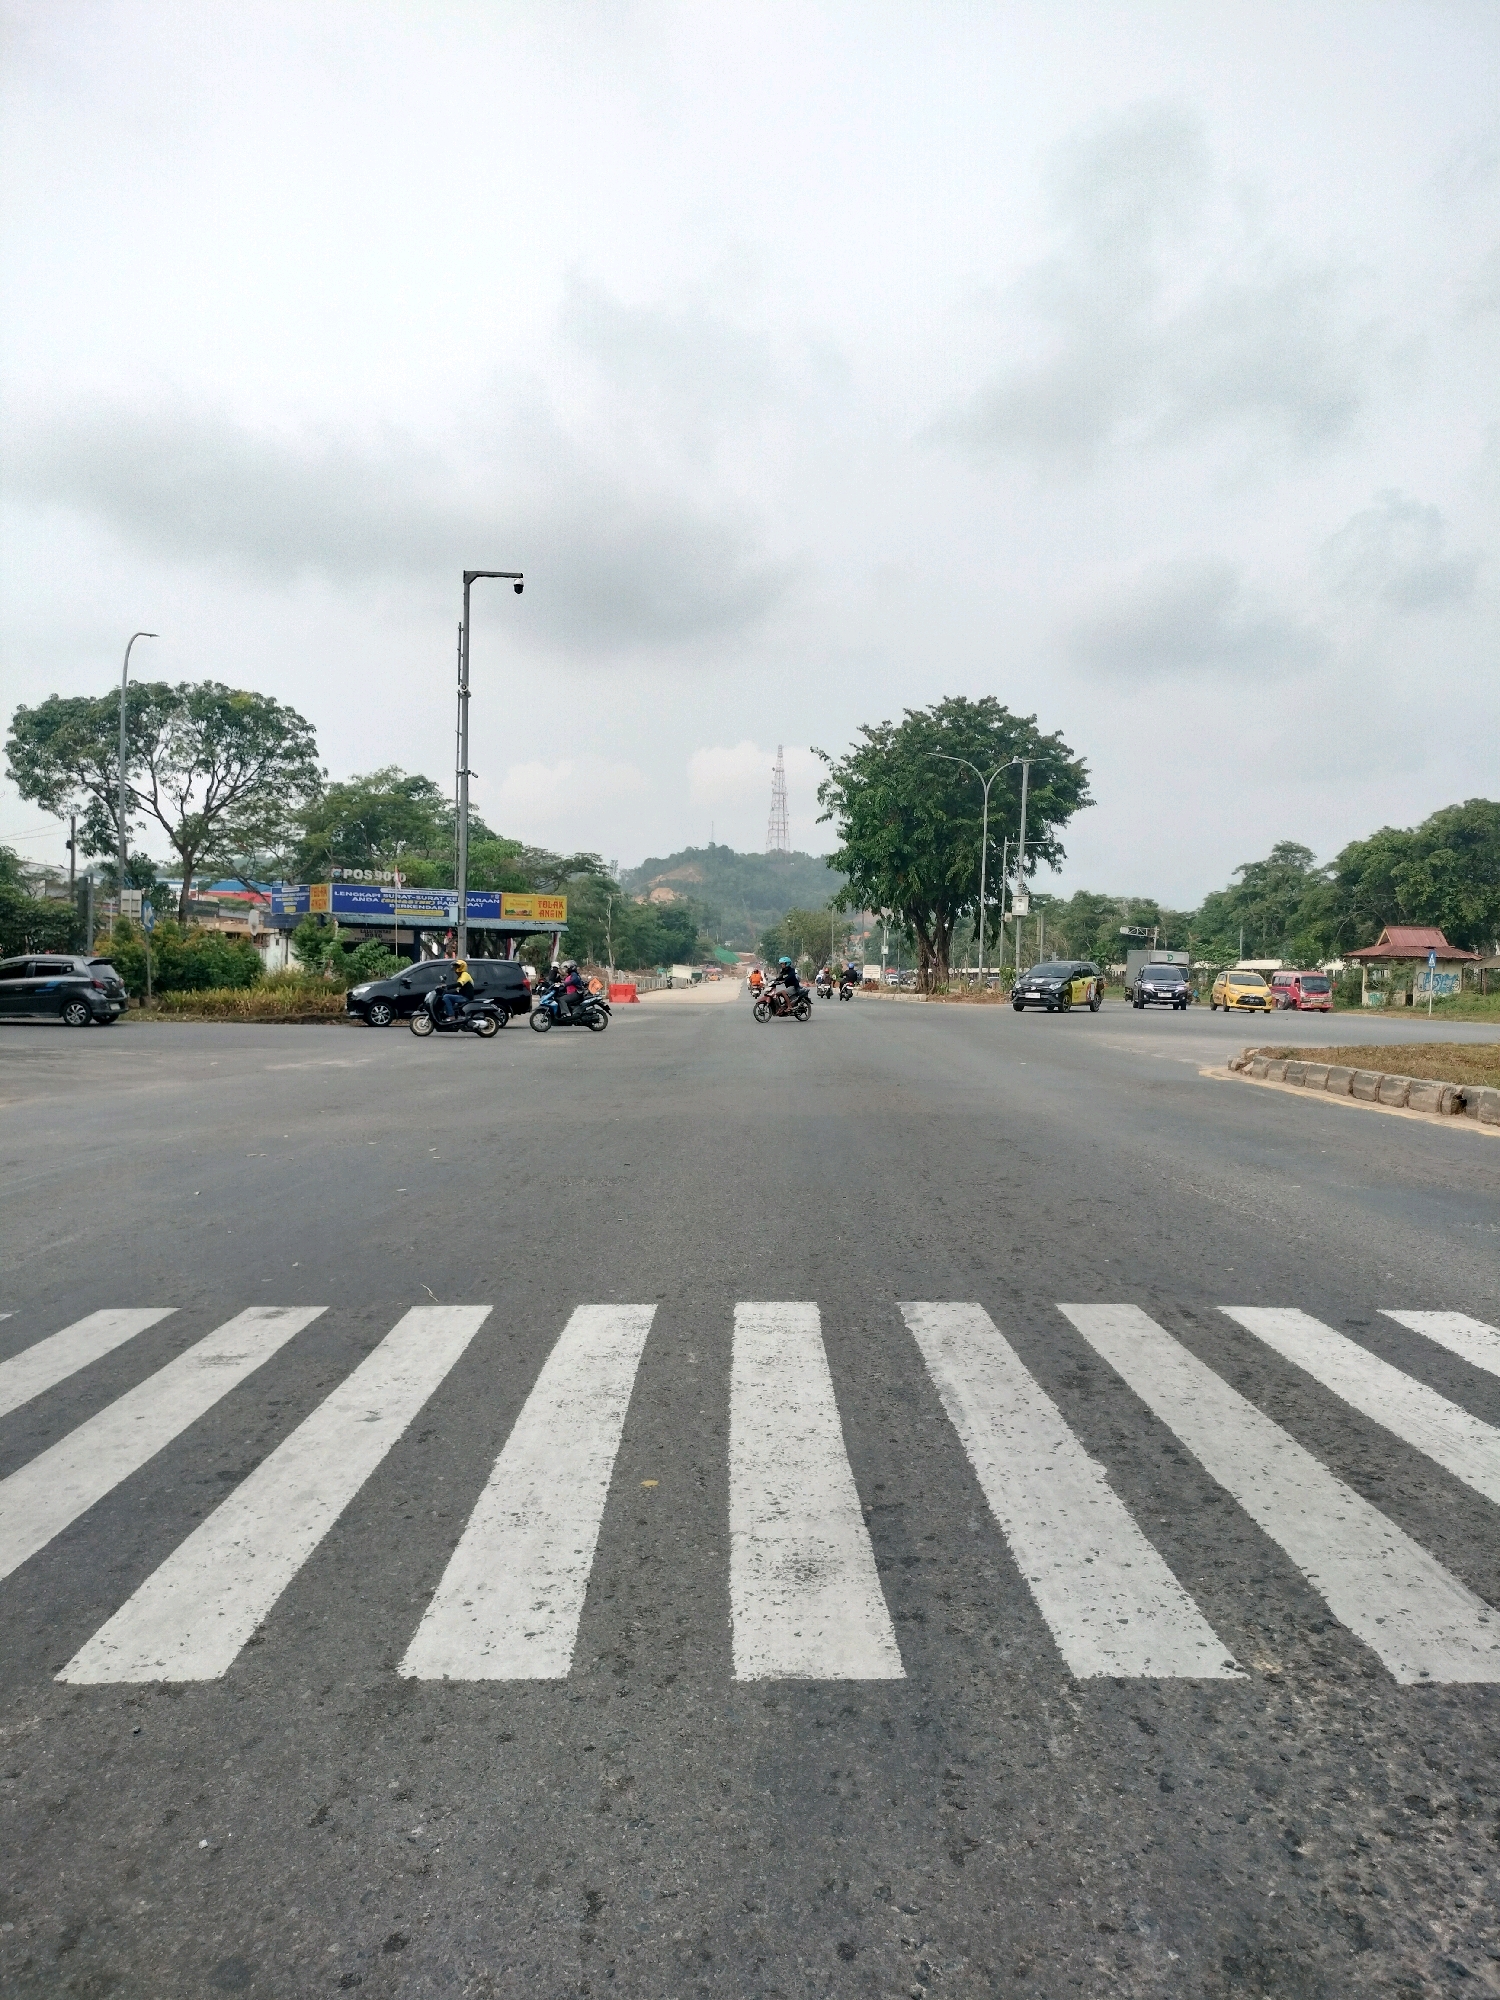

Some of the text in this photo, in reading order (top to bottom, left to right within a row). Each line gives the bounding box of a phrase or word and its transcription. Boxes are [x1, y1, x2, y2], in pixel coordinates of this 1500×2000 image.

[343, 868, 374, 880] POS
[382, 893, 445, 901] SURAT-SURAT
[389, 903, 450, 911] BERKENDARA
[538, 901, 564, 910] TOLAK
[538, 910, 563, 919] ANGIN
